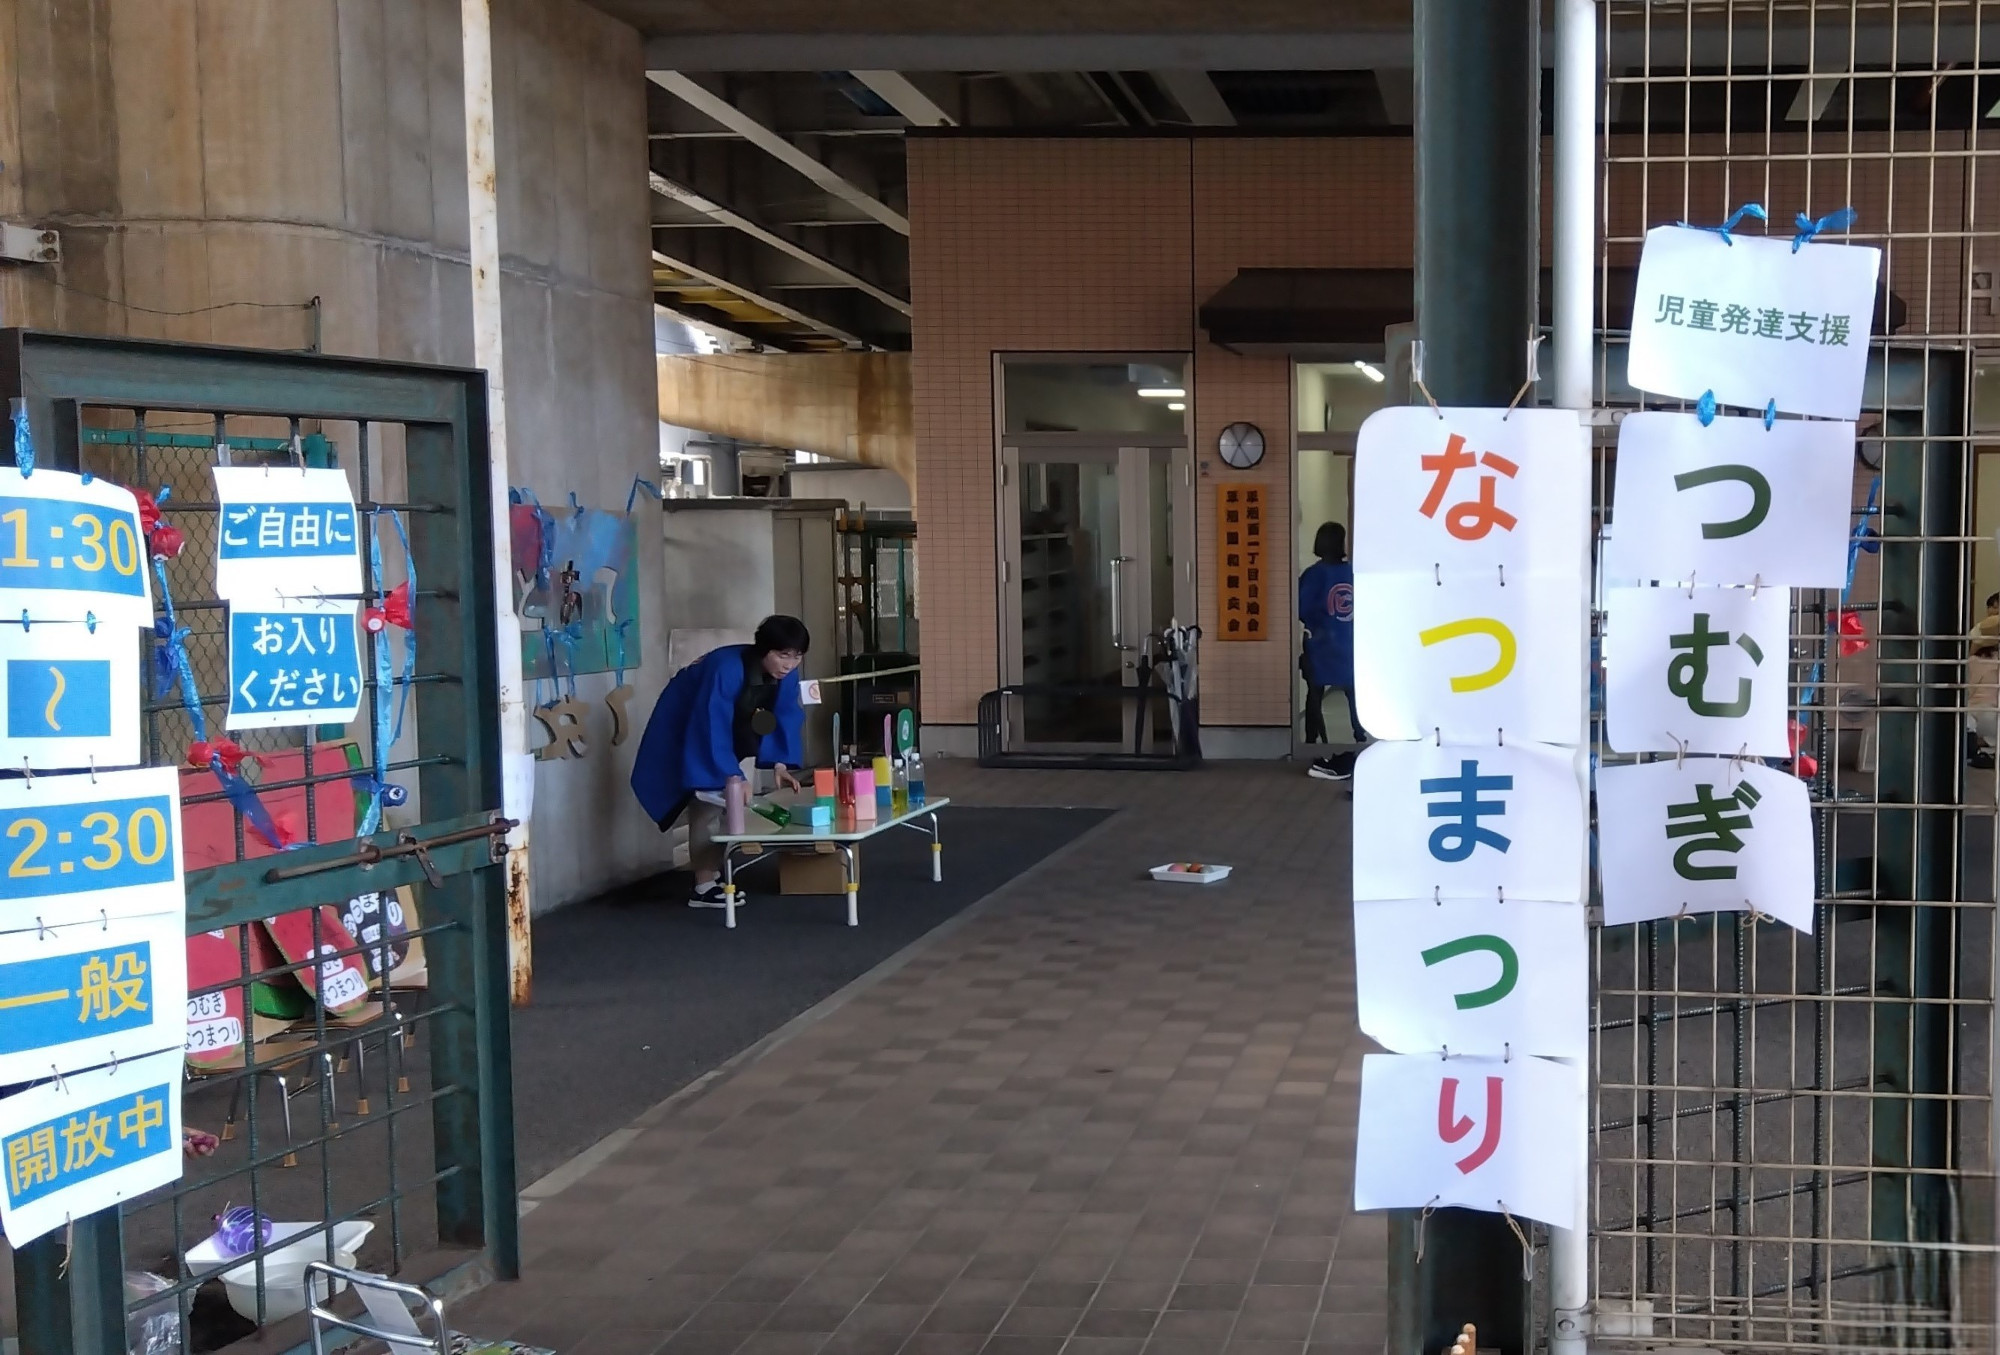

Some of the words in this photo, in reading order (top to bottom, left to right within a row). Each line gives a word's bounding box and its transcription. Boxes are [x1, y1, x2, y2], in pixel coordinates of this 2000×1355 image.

[1655, 294, 1850, 347] 児童発達支援
[1, 507, 138, 576] 1:30
[223, 506, 352, 548] ご自由に
[252, 616, 336, 656] お入り
[239, 669, 358, 710] ください
[1665, 464, 1772, 881] つむぎ
[1418, 433, 1520, 1176] なつまつり
[6, 808, 167, 878] 2:30
[0, 952, 148, 1023] 一般
[187, 992, 221, 1016] つむぎ
[322, 970, 364, 1005] つまつり
[8, 1095, 165, 1196] 開放中
